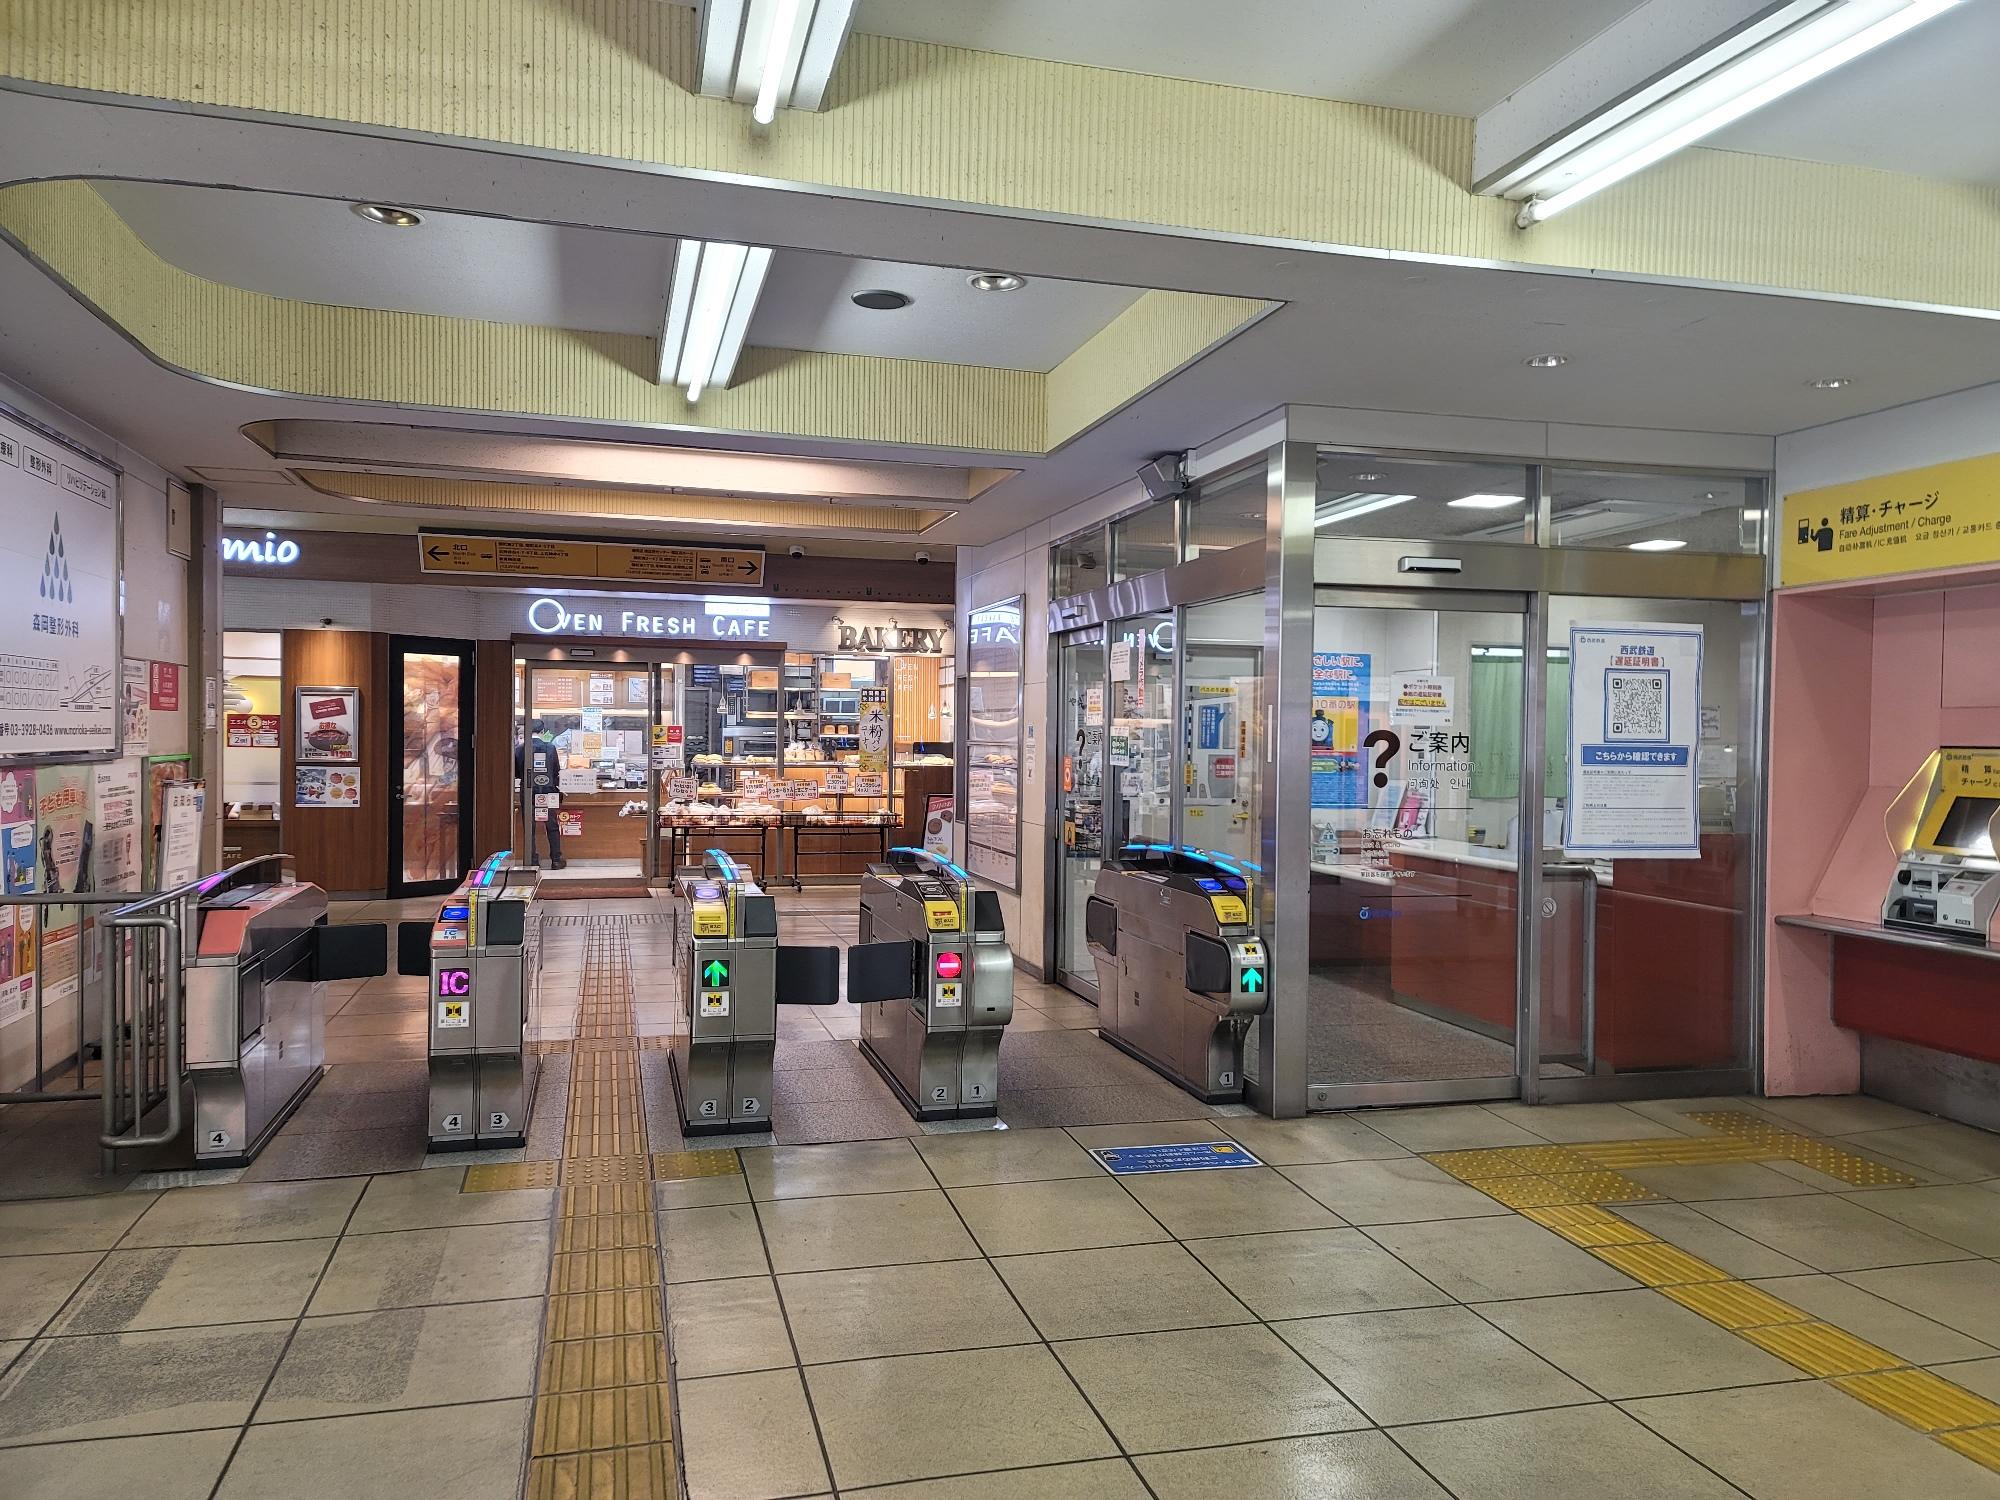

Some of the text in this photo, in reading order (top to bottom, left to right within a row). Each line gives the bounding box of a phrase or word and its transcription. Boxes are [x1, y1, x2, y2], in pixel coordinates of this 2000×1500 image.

[29, 455, 52, 477] 整形外科
[1840, 491, 1940, 525] 精算・チャージ
[1839, 529, 1857, 540] Fare
[1859, 520, 1909, 537] Adjustment
[1917, 514, 1952, 528] Charge
[221, 531, 300, 563] mio
[528, 598, 770, 637] OVEN FRESH CAFE
[33, 613, 79, 638] 森岡整形外科
[838, 625, 947, 653] BAKERY
[1620, 645, 1655, 655] 西武鉄道
[1409, 731, 1470, 754] ご案内
[1595, 752, 1678, 762] こちらから確認できます
[1408, 760, 1475, 772] Information
[1408, 778, 1440, 789] 问询处
[1450, 778, 1472, 790] 안내
[1961, 778, 1992, 786] チャージ
[1362, 828, 1413, 839] お忘れもの
[440, 970, 469, 996] IC
[1224, 1073, 1230, 1083] 1
[936, 1088, 945, 1098] 2
[973, 1086, 981, 1095] 1
[705, 1101, 714, 1112] 3
[744, 1099, 754, 1110] 2
[448, 1116, 459, 1127] 4
[493, 1114, 503, 1125] 3
[212, 1133, 224, 1144] 4
